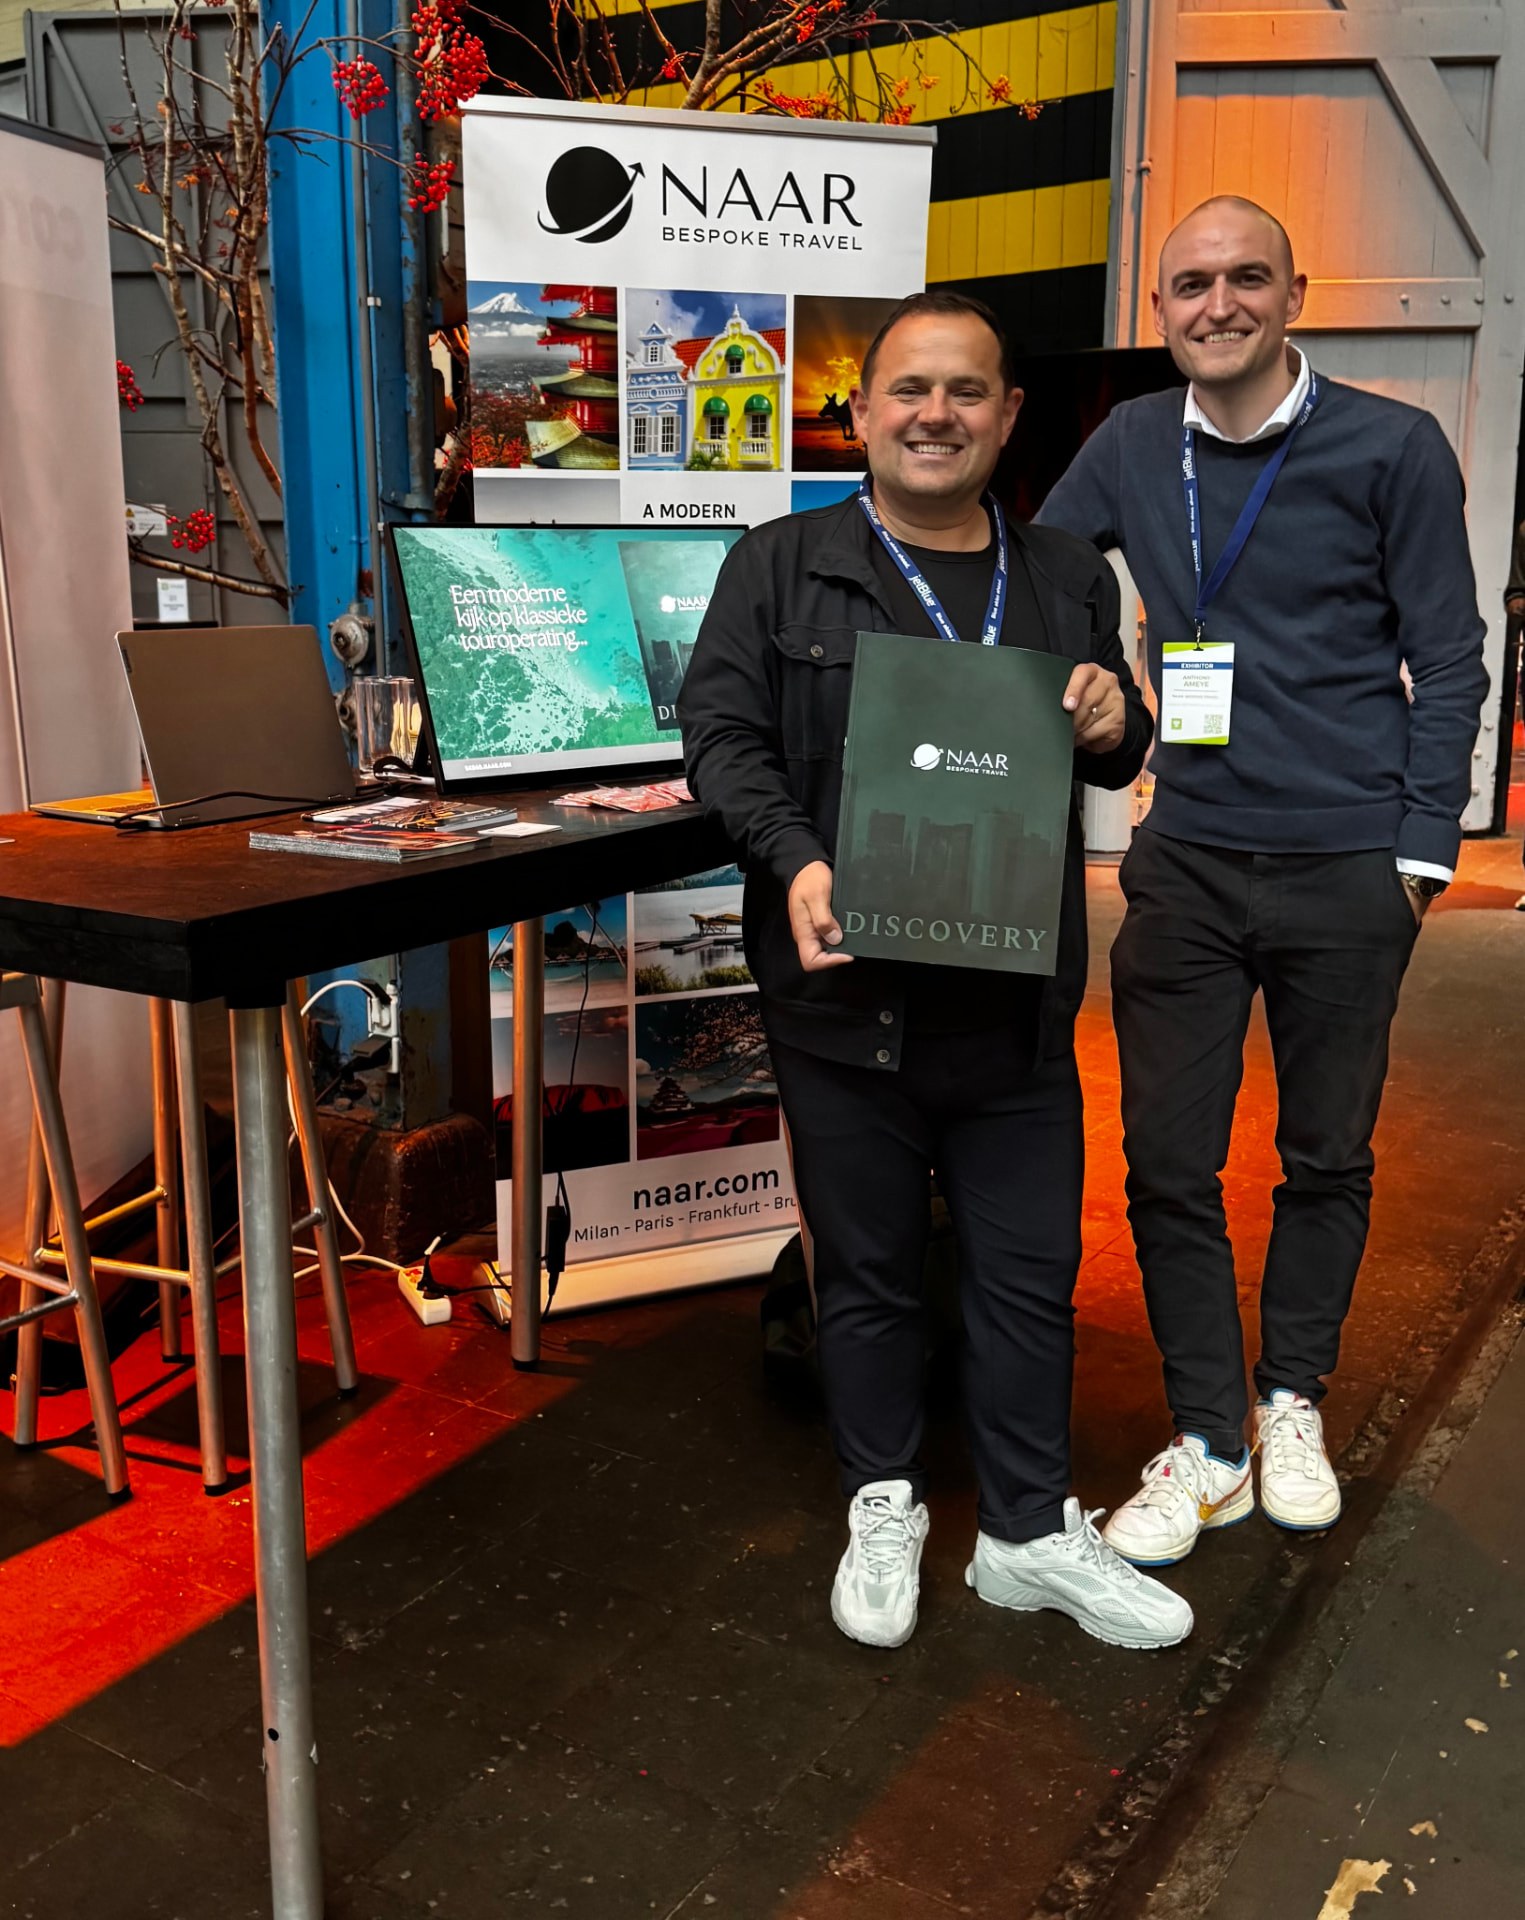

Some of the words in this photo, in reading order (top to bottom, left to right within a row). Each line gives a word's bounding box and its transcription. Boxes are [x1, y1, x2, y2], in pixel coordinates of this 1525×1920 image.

[662, 163, 863, 227] NAAR
[662, 227, 769, 246] BESPOKE
[778, 232, 863, 250] TRAVEL
[1183, 447, 1196, 481] jetBlue
[643, 504, 655, 518] A
[660, 504, 736, 518] MODERN
[450, 585, 486, 604] Een
[488, 582, 567, 603] moderne
[677, 595, 708, 606] NAAR
[909, 574, 937, 607] jetBlue
[454, 606, 488, 632] kijk
[488, 611, 513, 631] op
[514, 603, 588, 625] klassieke
[946, 748, 1009, 771] NAAR
[946, 765, 979, 774] BESPOKE
[982, 768, 1009, 777] TRAVEL
[844, 911, 1047, 952] DISCOVERY
[633, 1168, 779, 1210] naar.com
[574, 1225, 619, 1243] Milan
[635, 1214, 674, 1233] Paris
[689, 1200, 761, 1224] Frankfurt
